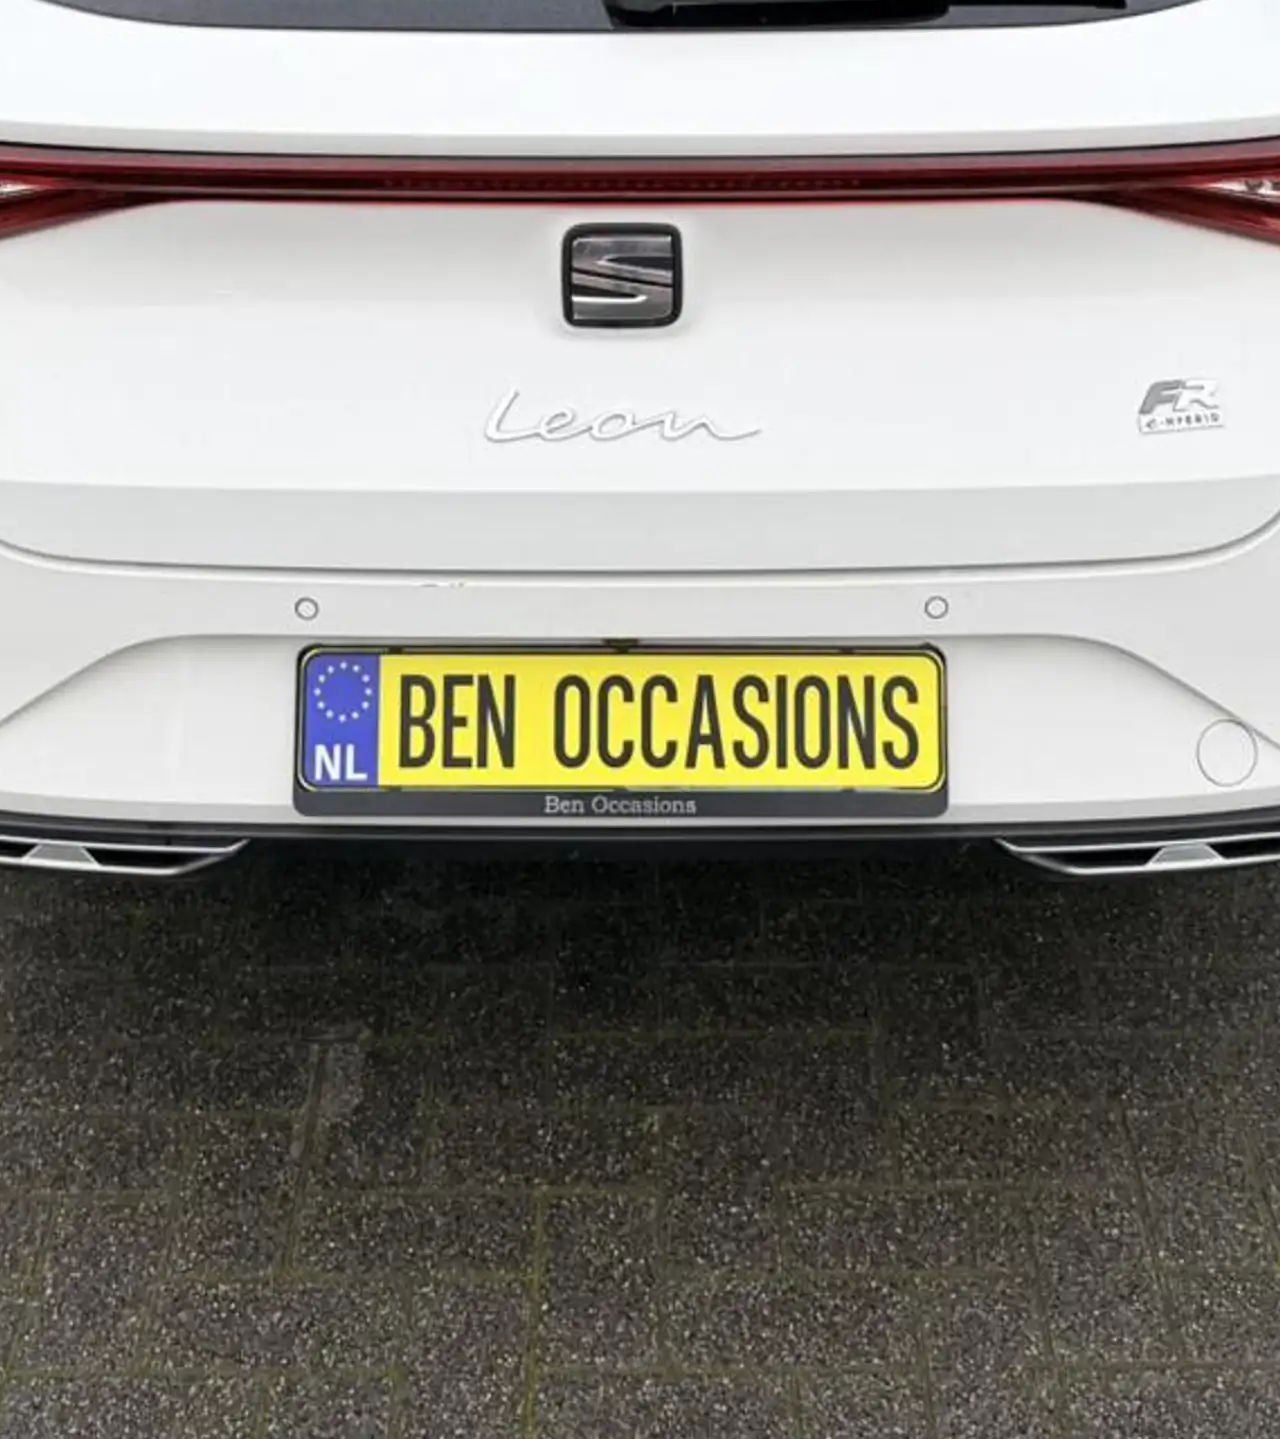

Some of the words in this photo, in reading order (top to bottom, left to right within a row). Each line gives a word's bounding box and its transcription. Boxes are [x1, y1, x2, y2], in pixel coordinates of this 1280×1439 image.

[1139, 378, 1220, 415] FR
[484, 388, 762, 443] Leon
[398, 674, 516, 769] BEN
[554, 674, 920, 769] OCCASIONS
[314, 744, 367, 781] NL
[544, 795, 585, 814] Ben
[591, 795, 697, 815] Occasions
